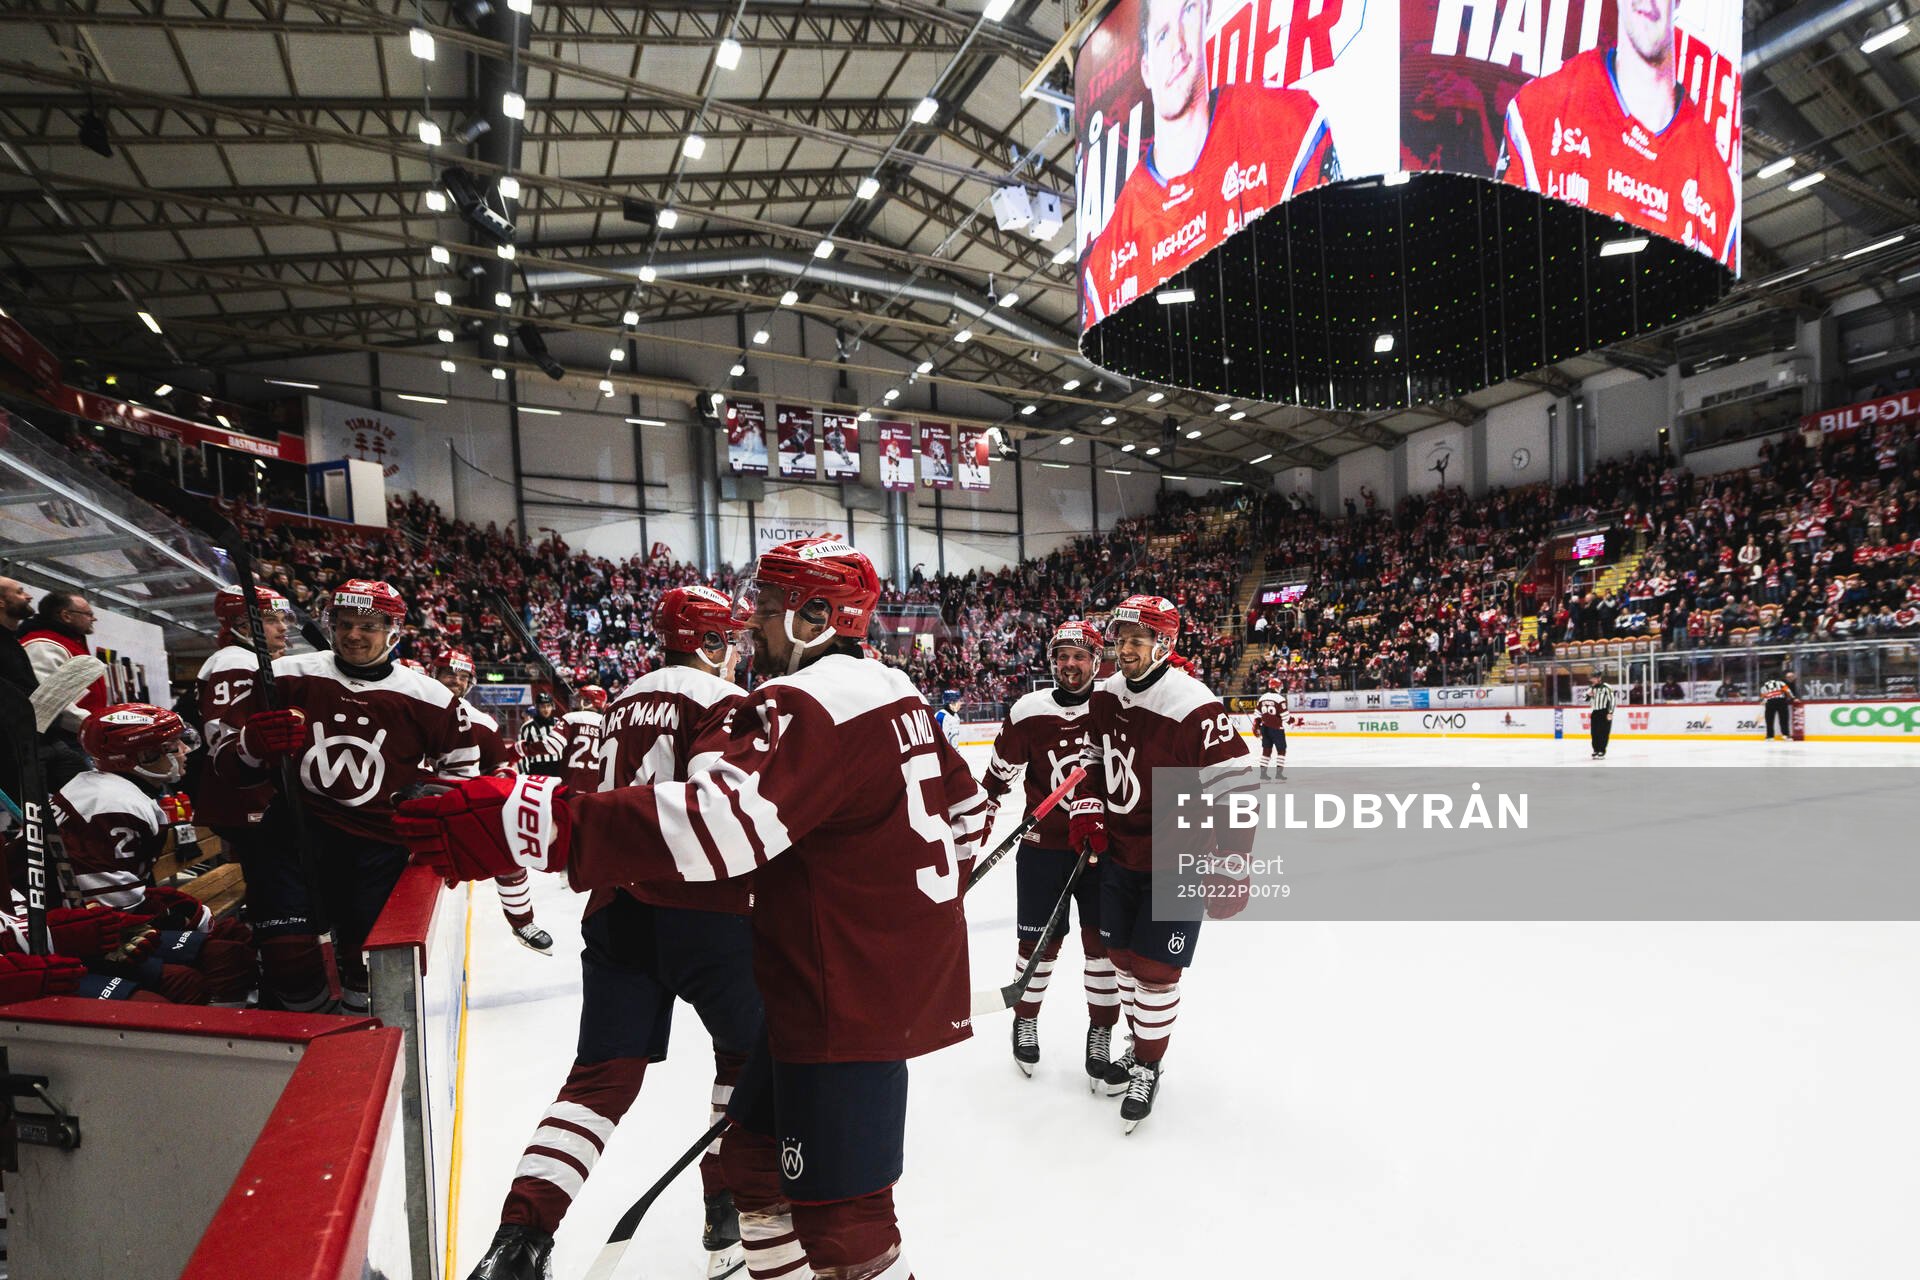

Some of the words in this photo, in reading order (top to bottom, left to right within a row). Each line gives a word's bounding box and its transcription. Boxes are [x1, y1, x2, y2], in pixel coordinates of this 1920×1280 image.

[1820, 397, 1920, 433] BILBOL
[345, 593, 372, 606] LILIUM
[600, 701, 680, 739] ARMANN
[1358, 721, 1399, 732] TIRAB
[1423, 713, 1466, 729] CAMO
[1687, 720, 1706, 729] 24V
[1736, 720, 1758, 729] 24V
[1830, 706, 1920, 732] coop
[1201, 712, 1235, 750] 29
[901, 752, 959, 904] 5
